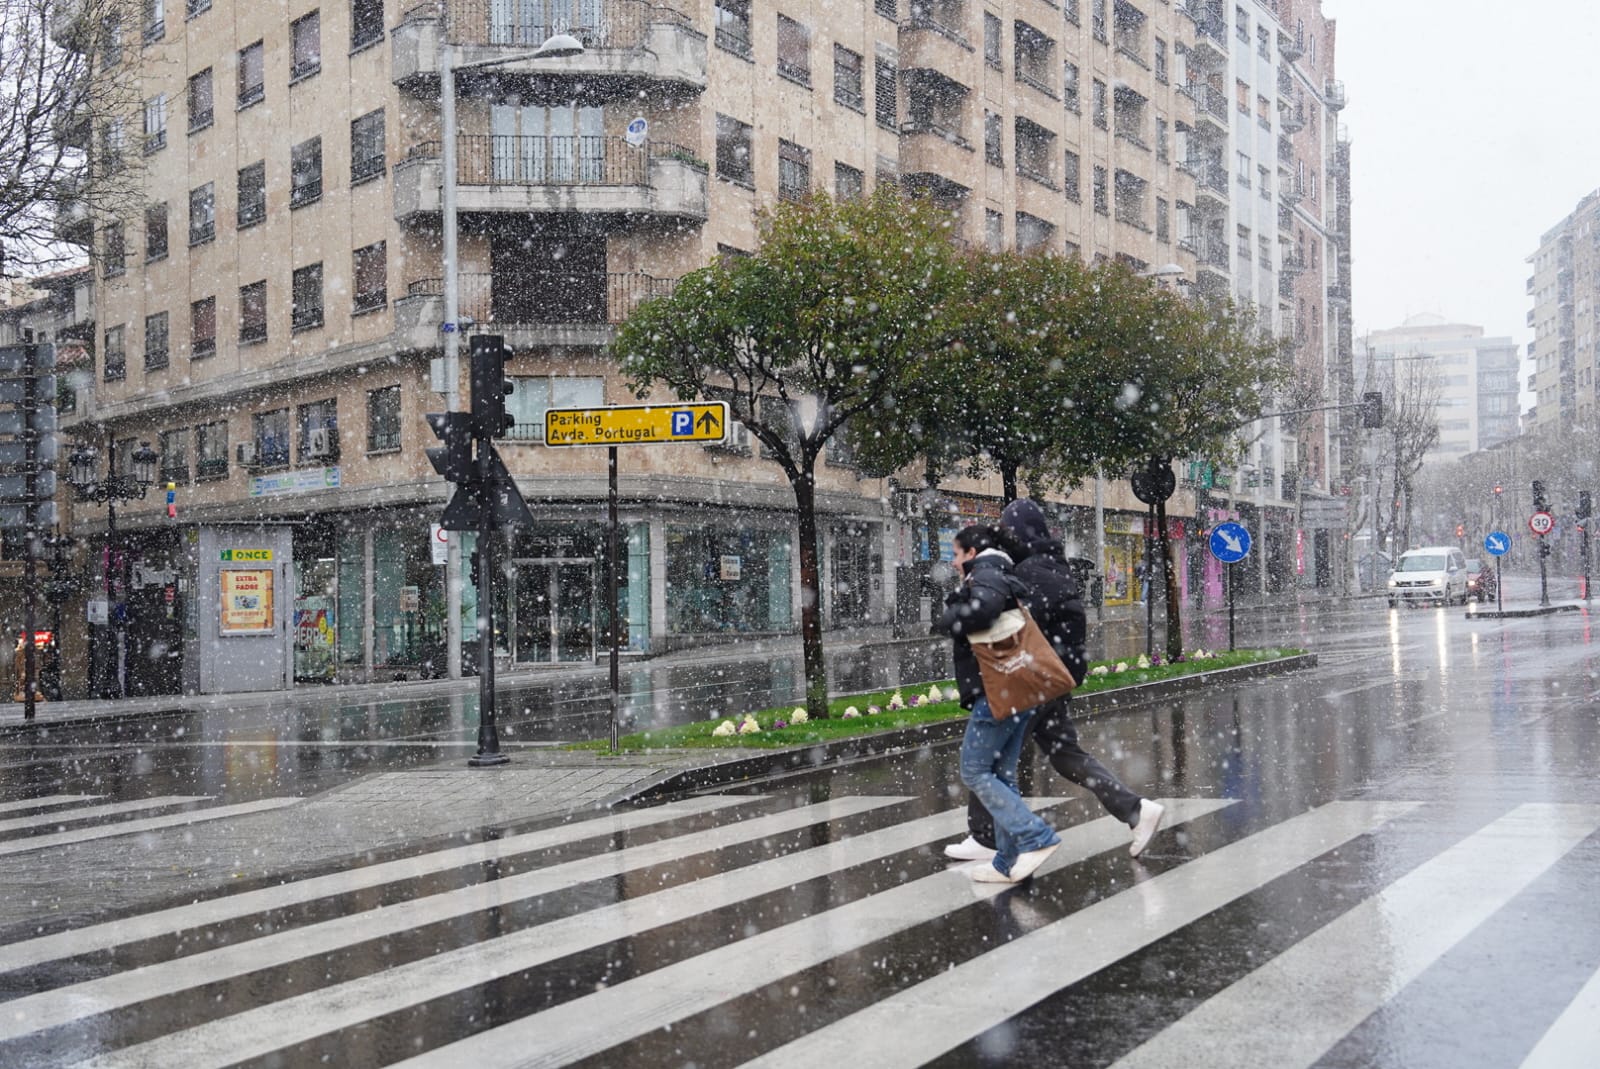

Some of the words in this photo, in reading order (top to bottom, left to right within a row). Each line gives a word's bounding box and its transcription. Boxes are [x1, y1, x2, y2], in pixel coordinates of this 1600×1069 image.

[550, 413, 601, 426] Parking
[551, 428, 589, 440] Avda.
[595, 425, 655, 440] Portugal
[1534, 518, 1549, 527] 30
[236, 551, 268, 559] ONCE
